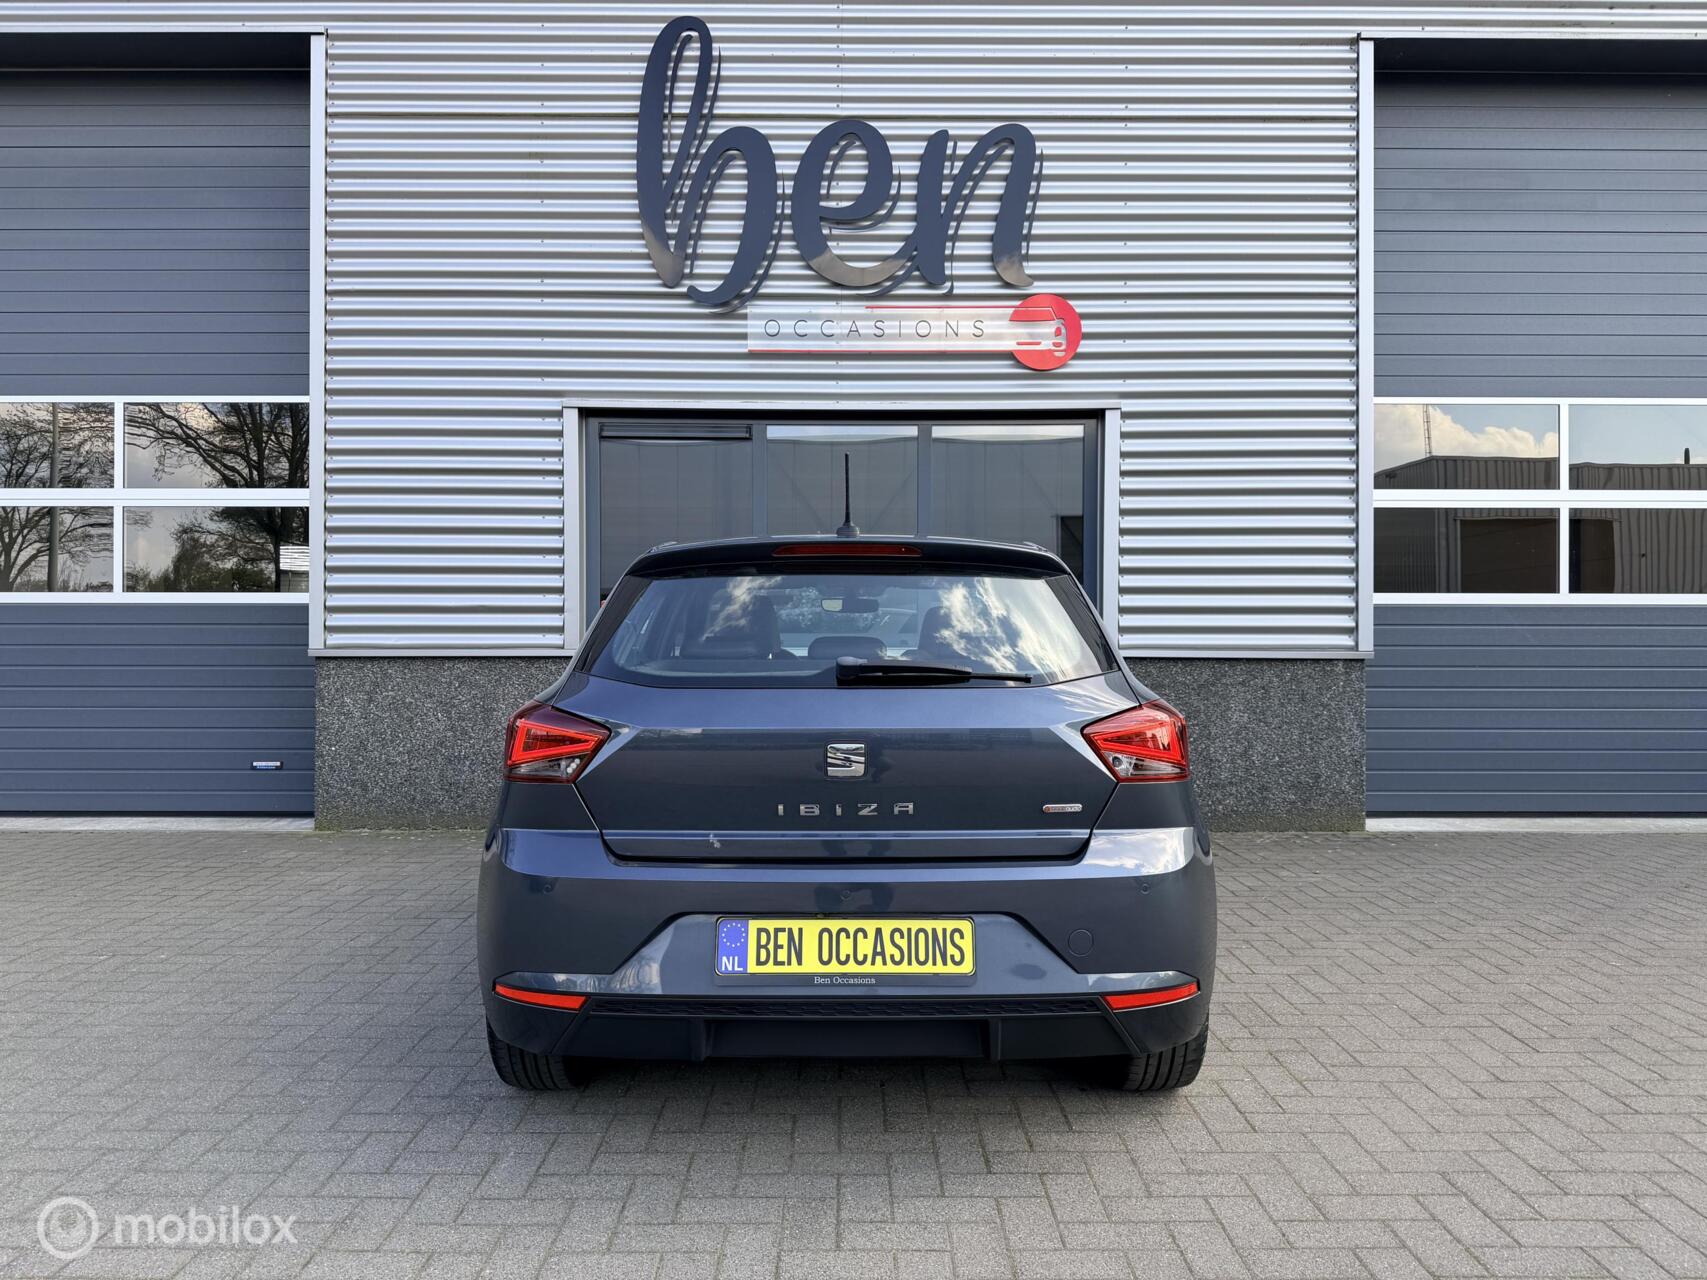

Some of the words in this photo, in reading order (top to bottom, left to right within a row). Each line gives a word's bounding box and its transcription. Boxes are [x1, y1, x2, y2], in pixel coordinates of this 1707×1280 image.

[636, 15, 1042, 310] ben
[763, 318, 986, 339] OCCASIONS
[777, 802, 914, 816] IBIZA
[755, 927, 804, 967] BEN
[817, 927, 966, 967] OCCASIONS
[721, 955, 744, 972] NL
[814, 976, 831, 985] Ben
[833, 976, 876, 985] Occasions
